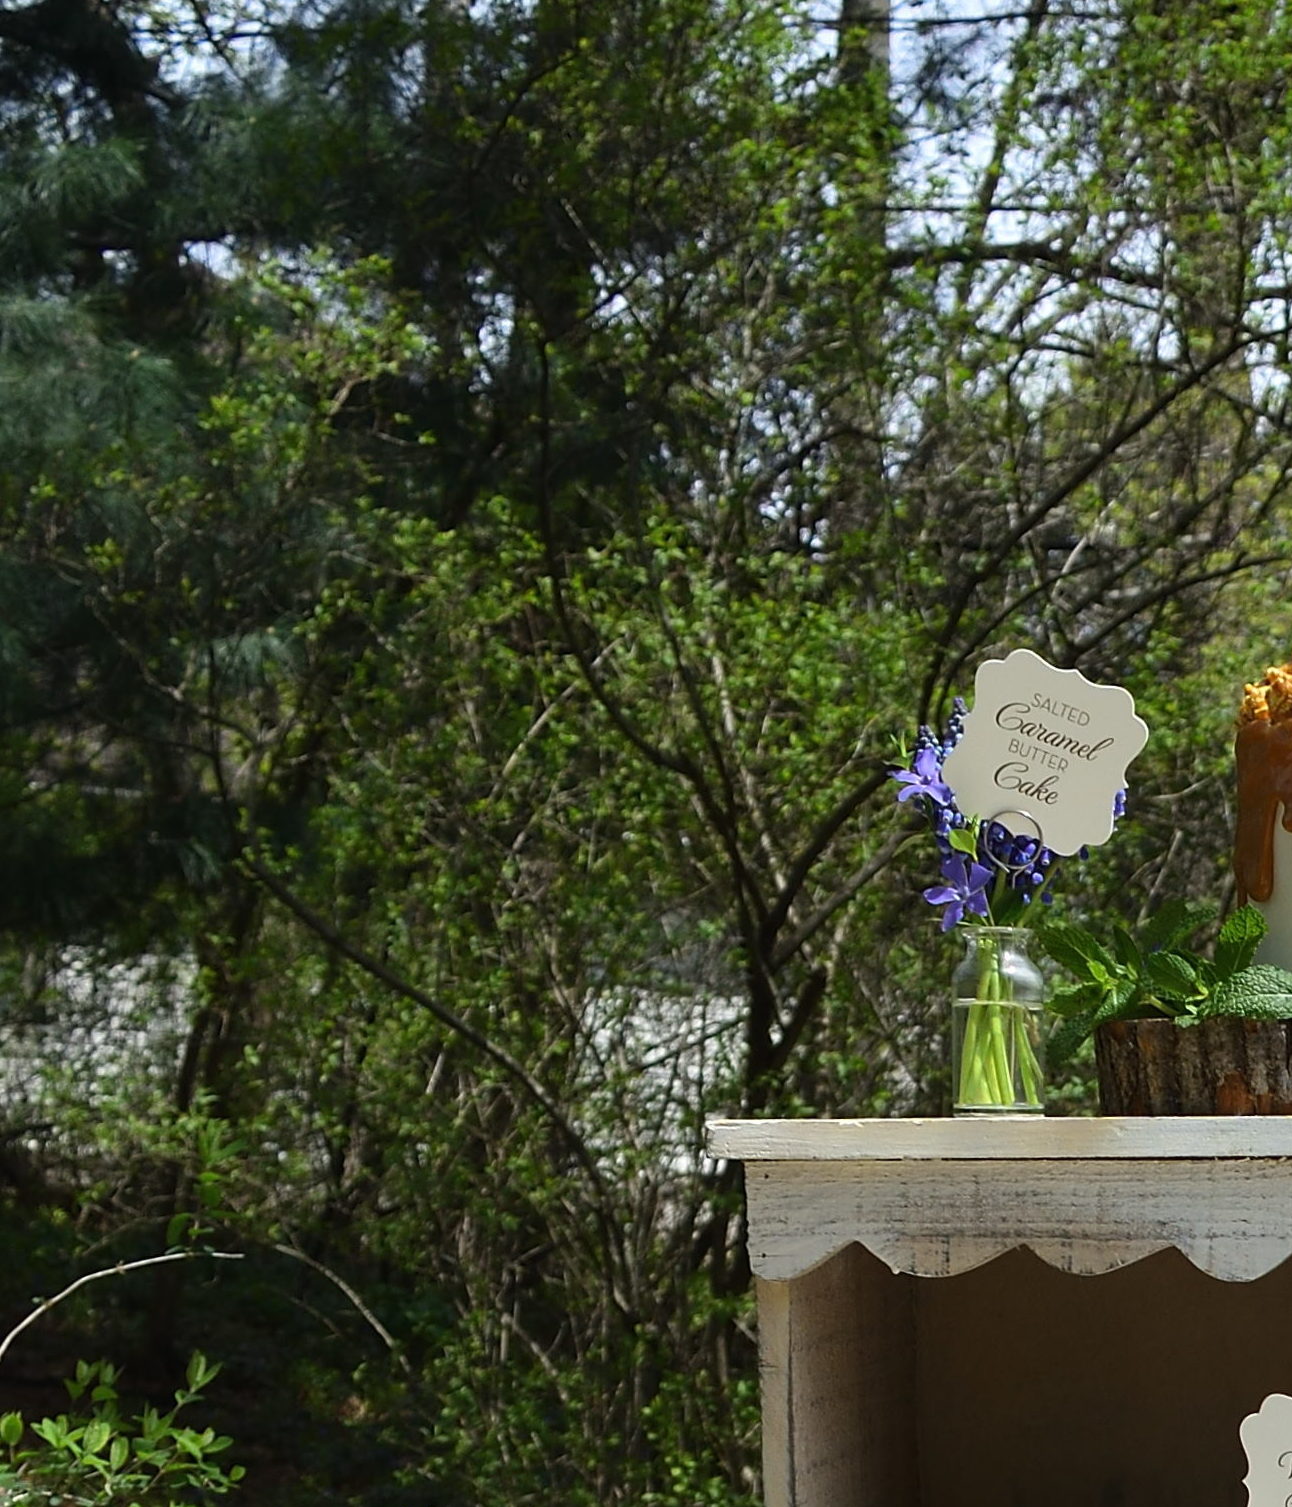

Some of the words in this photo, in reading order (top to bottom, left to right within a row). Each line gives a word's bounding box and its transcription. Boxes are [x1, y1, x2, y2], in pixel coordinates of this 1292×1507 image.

[1032, 692, 1090, 727] SALTED
[995, 702, 1114, 762] Caramel
[1008, 738, 1069, 773] BUTTER
[994, 761, 1060, 805] Cake
